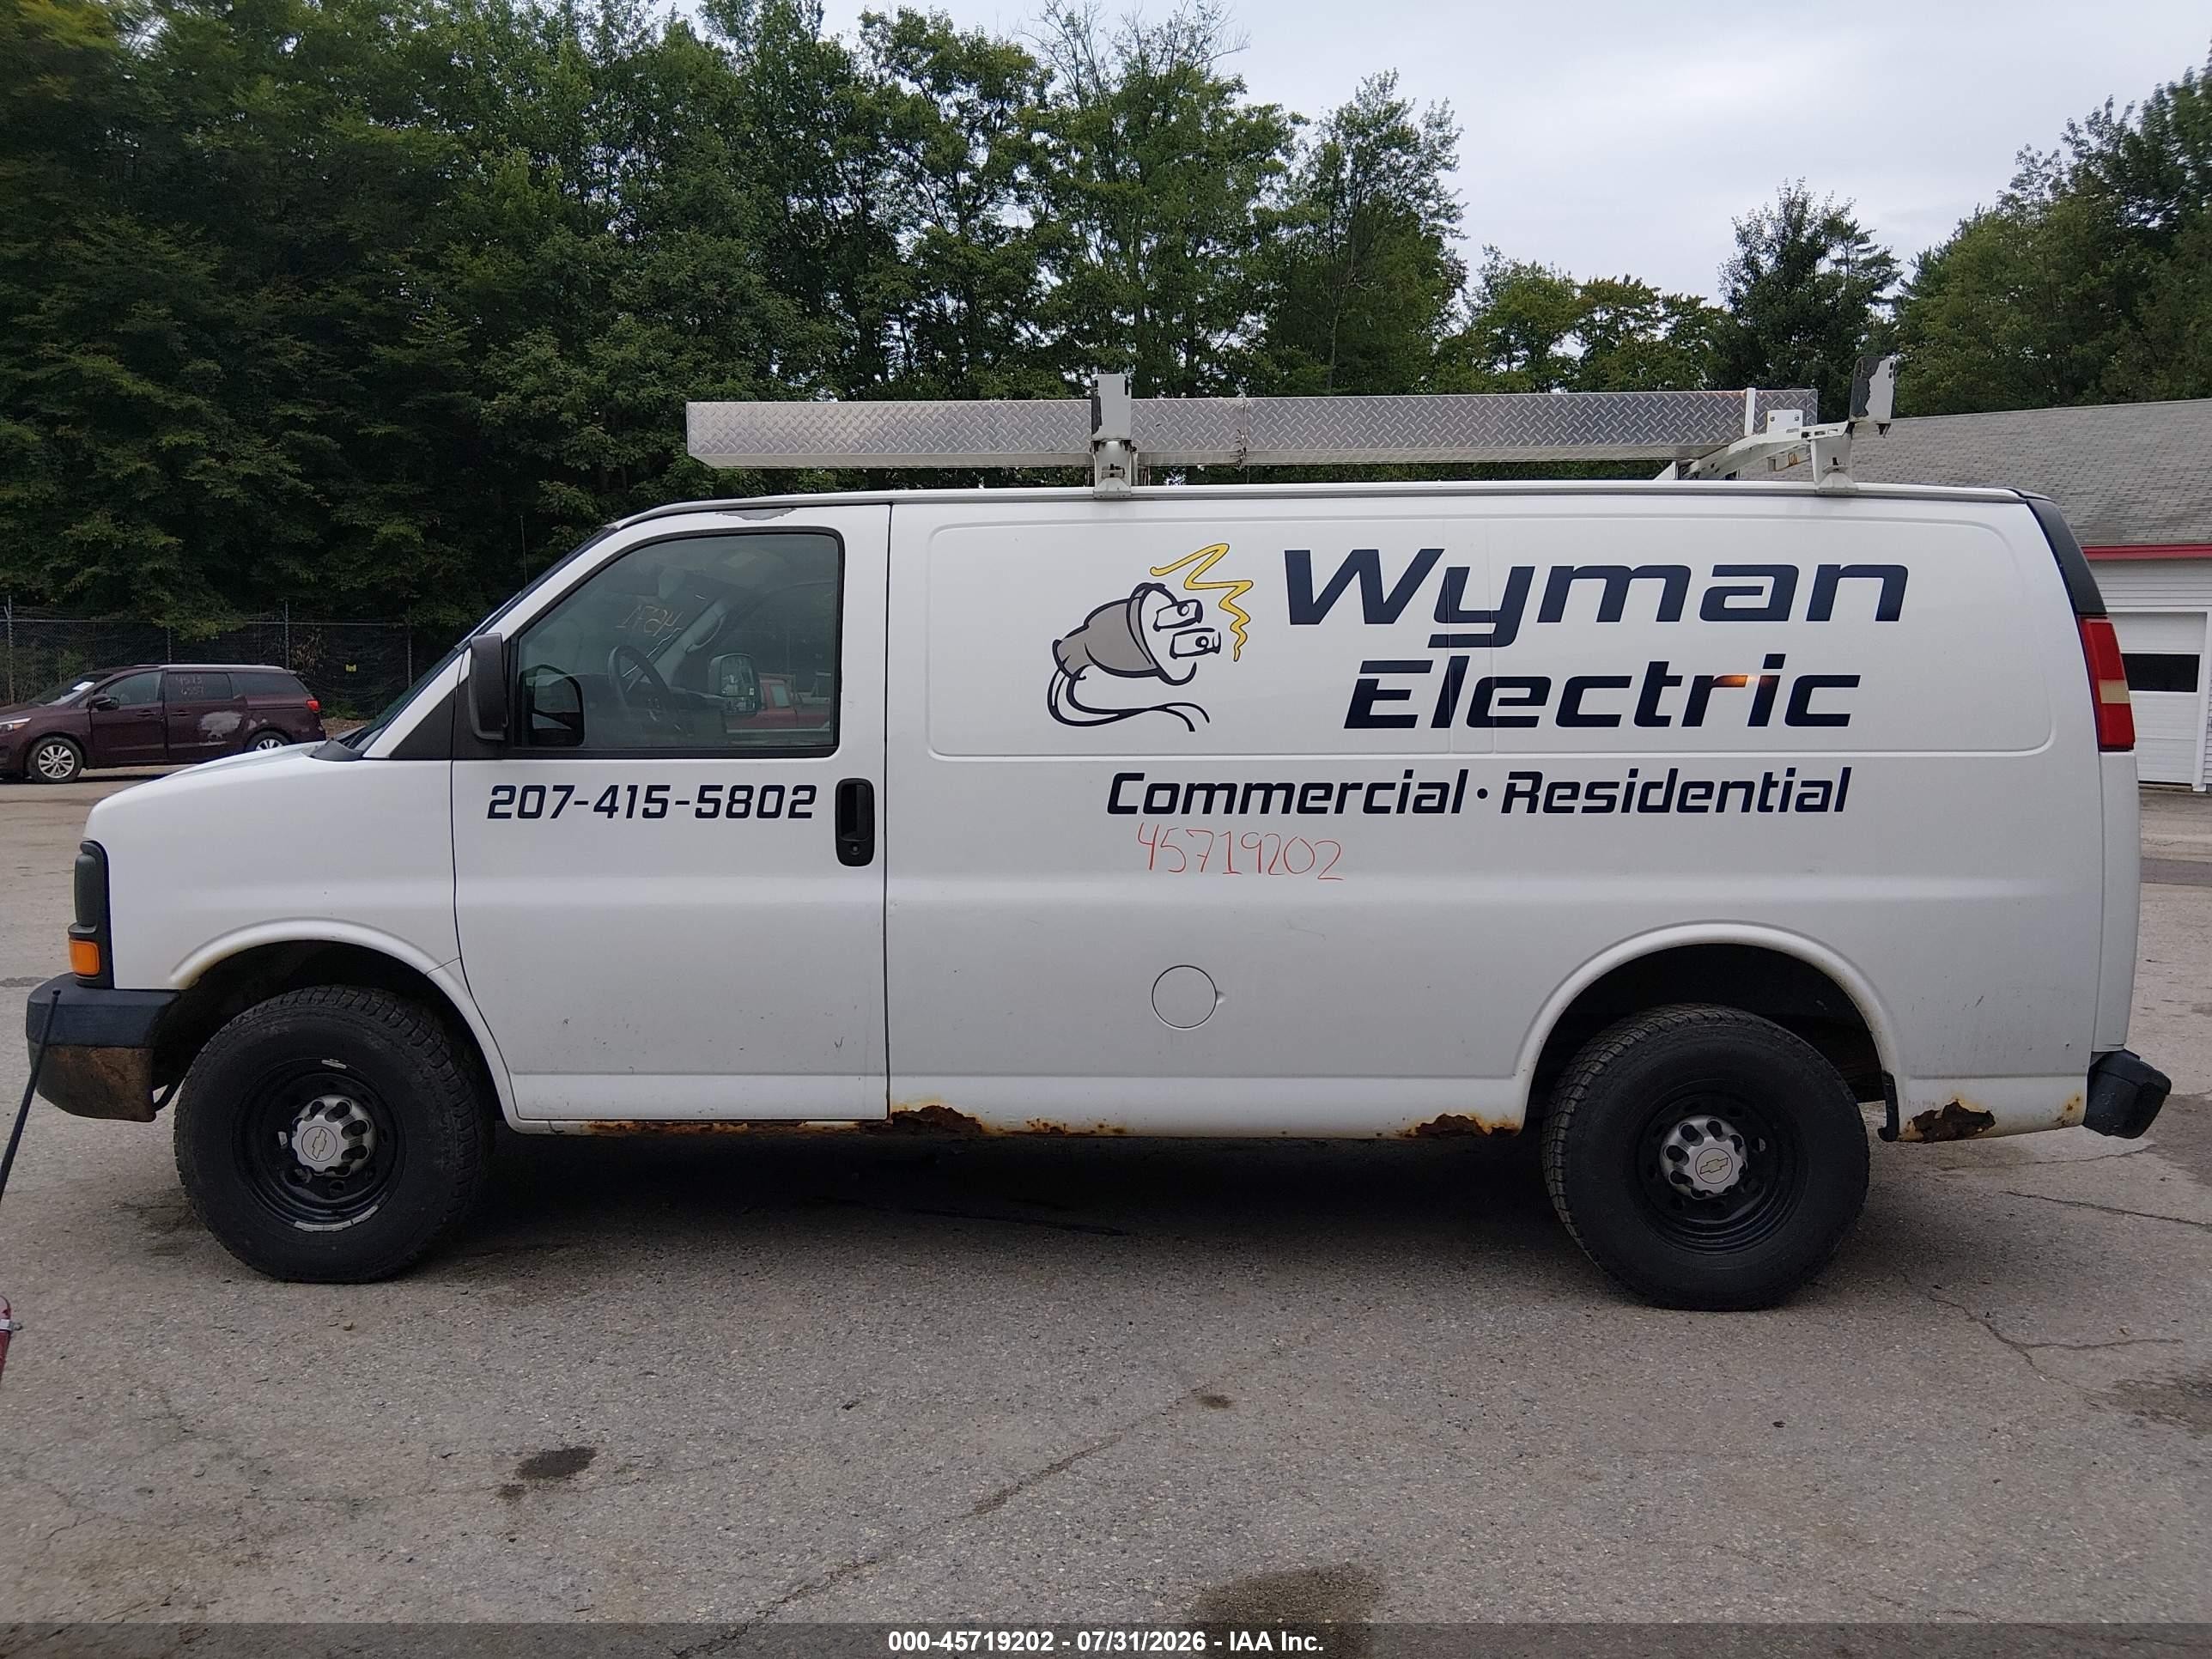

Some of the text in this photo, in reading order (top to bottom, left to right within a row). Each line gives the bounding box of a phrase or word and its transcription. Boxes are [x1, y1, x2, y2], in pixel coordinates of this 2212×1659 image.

[1284, 548, 1910, 649] Wyman
[1343, 653, 1862, 730] Electric
[486, 784, 817, 819] 207-415-5802
[1107, 769, 1469, 815] Commercial
[1500, 766, 1852, 814] Residential
[1136, 822, 1345, 881] 45719202
